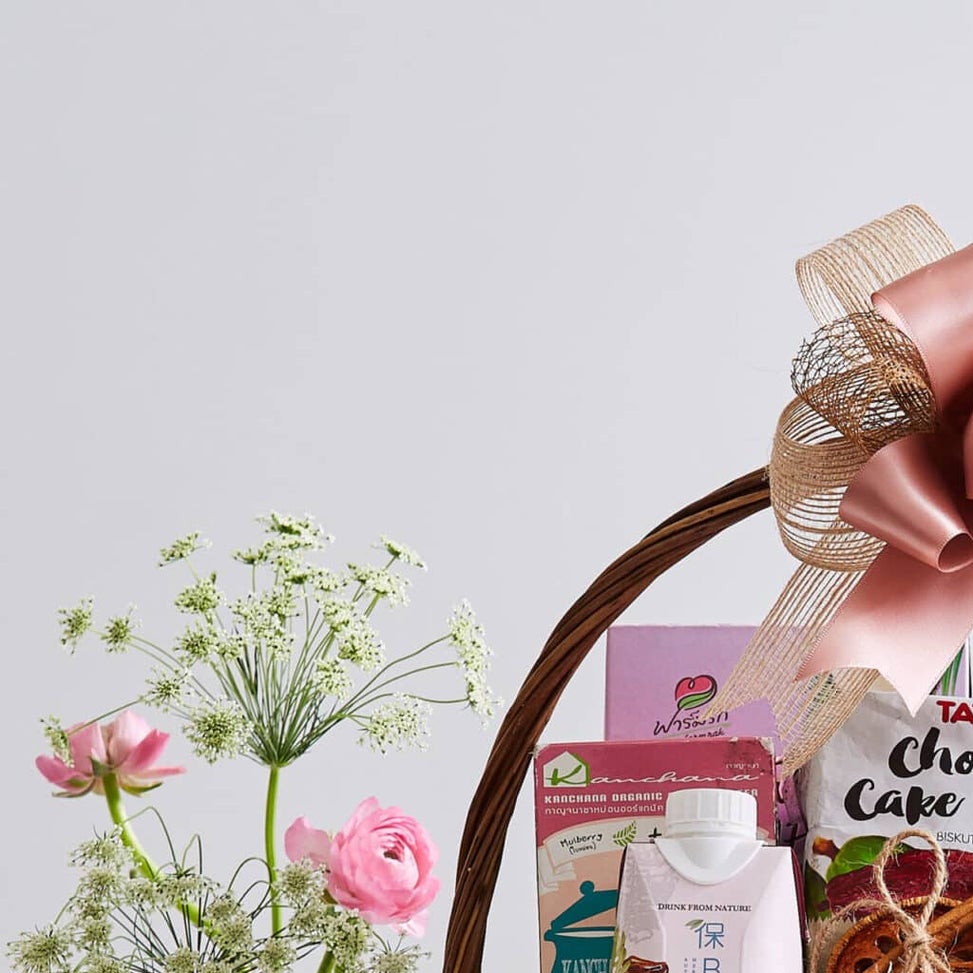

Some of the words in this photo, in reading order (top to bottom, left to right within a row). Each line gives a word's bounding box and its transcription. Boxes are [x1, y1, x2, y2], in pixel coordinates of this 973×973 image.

[544, 794, 607, 804] KANCHANA
[611, 792, 664, 803] ORGANIC
[844, 778, 966, 825] Cake
[560, 834, 603, 849] Mulberry
[658, 903, 687, 911] DRINK
[688, 903, 713, 912] FROM
[714, 904, 752, 912] NATURE
[694, 922, 725, 949] 保
